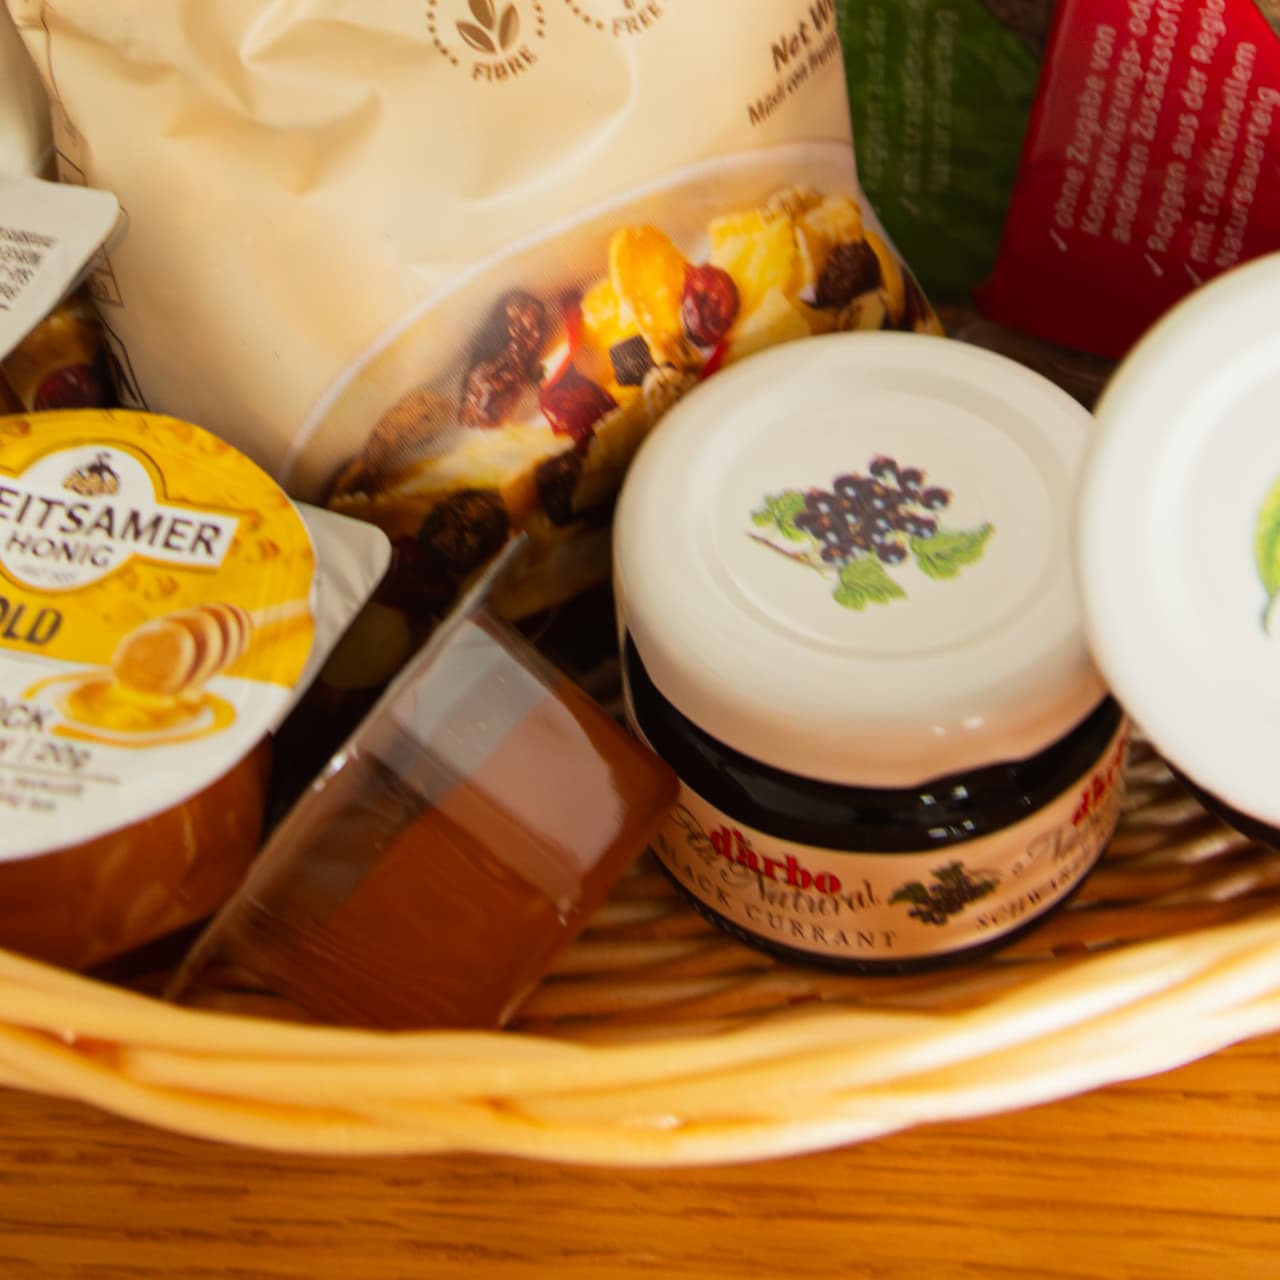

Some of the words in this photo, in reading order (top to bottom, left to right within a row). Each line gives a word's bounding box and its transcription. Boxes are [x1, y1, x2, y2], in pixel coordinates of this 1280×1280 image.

[611, 0, 665, 38] FREE
[471, 44, 539, 83] FIBRE
[1090, 24, 1117, 71] von
[1181, 65, 1209, 110] der
[1065, 74, 1107, 166] Zugabe
[1172, 114, 1199, 159] aus
[1199, 40, 1257, 217] traditionellem
[1056, 167, 1085, 230] ohne
[1111, 143, 1151, 244] anderen
[1146, 161, 1187, 254] Roggen
[1190, 221, 1215, 265] mit
[5, 529, 114, 568] HONIG
[745, 903, 899, 950] CURRANT
